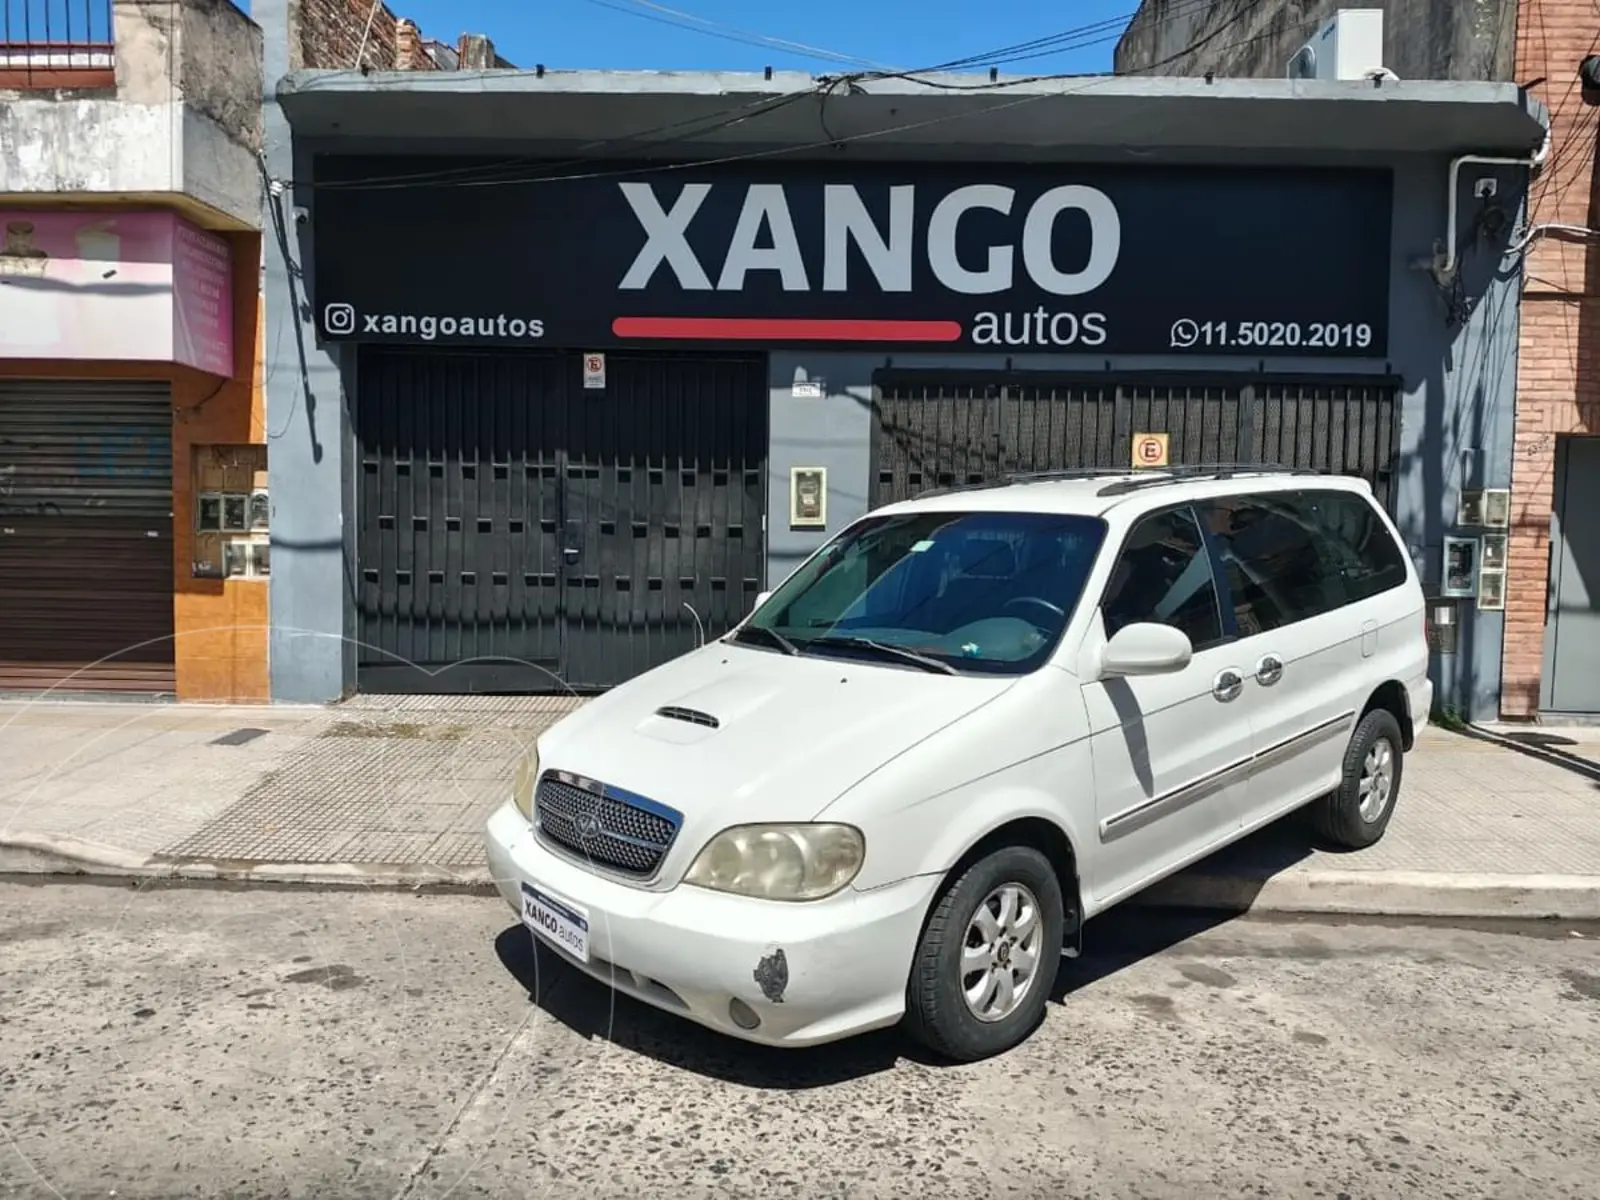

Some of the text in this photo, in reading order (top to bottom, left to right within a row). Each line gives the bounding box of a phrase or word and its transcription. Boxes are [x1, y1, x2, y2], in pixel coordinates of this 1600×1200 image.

[617, 182, 1121, 295] XANGO
[363, 314, 545, 340] xangoautos
[971, 305, 1108, 346] autos
[1200, 320, 1373, 347] 11.5020.2019
[1144, 442, 1157, 458] E
[525, 898, 558, 934] XANGO
[558, 924, 584, 953] autos
